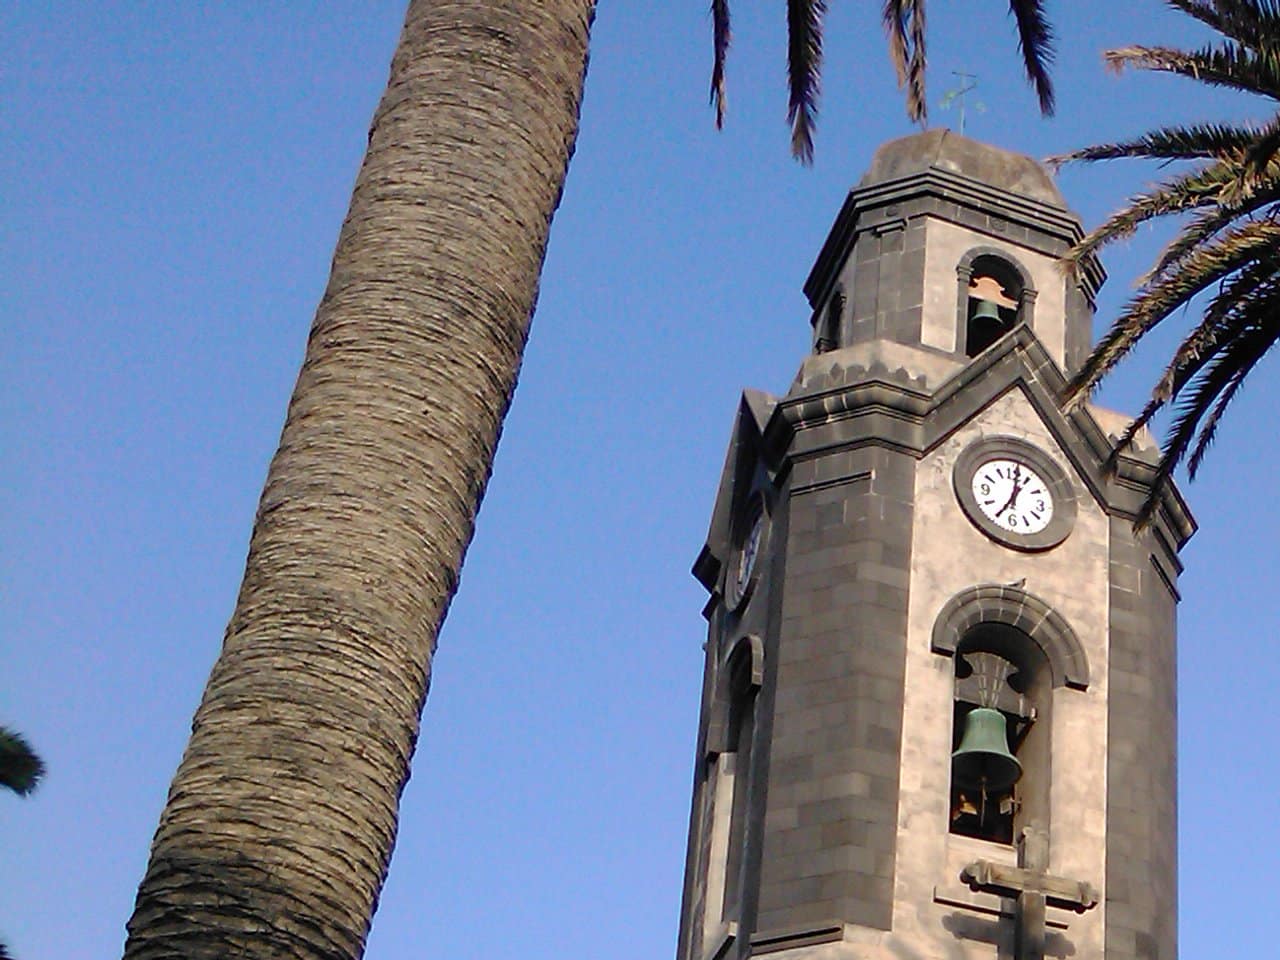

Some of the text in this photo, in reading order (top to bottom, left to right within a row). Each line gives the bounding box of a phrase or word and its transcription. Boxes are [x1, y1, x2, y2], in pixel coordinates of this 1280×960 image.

[981, 483, 991, 496] 9
[1036, 499, 1045, 512] 3
[1008, 514, 1018, 527] 6
